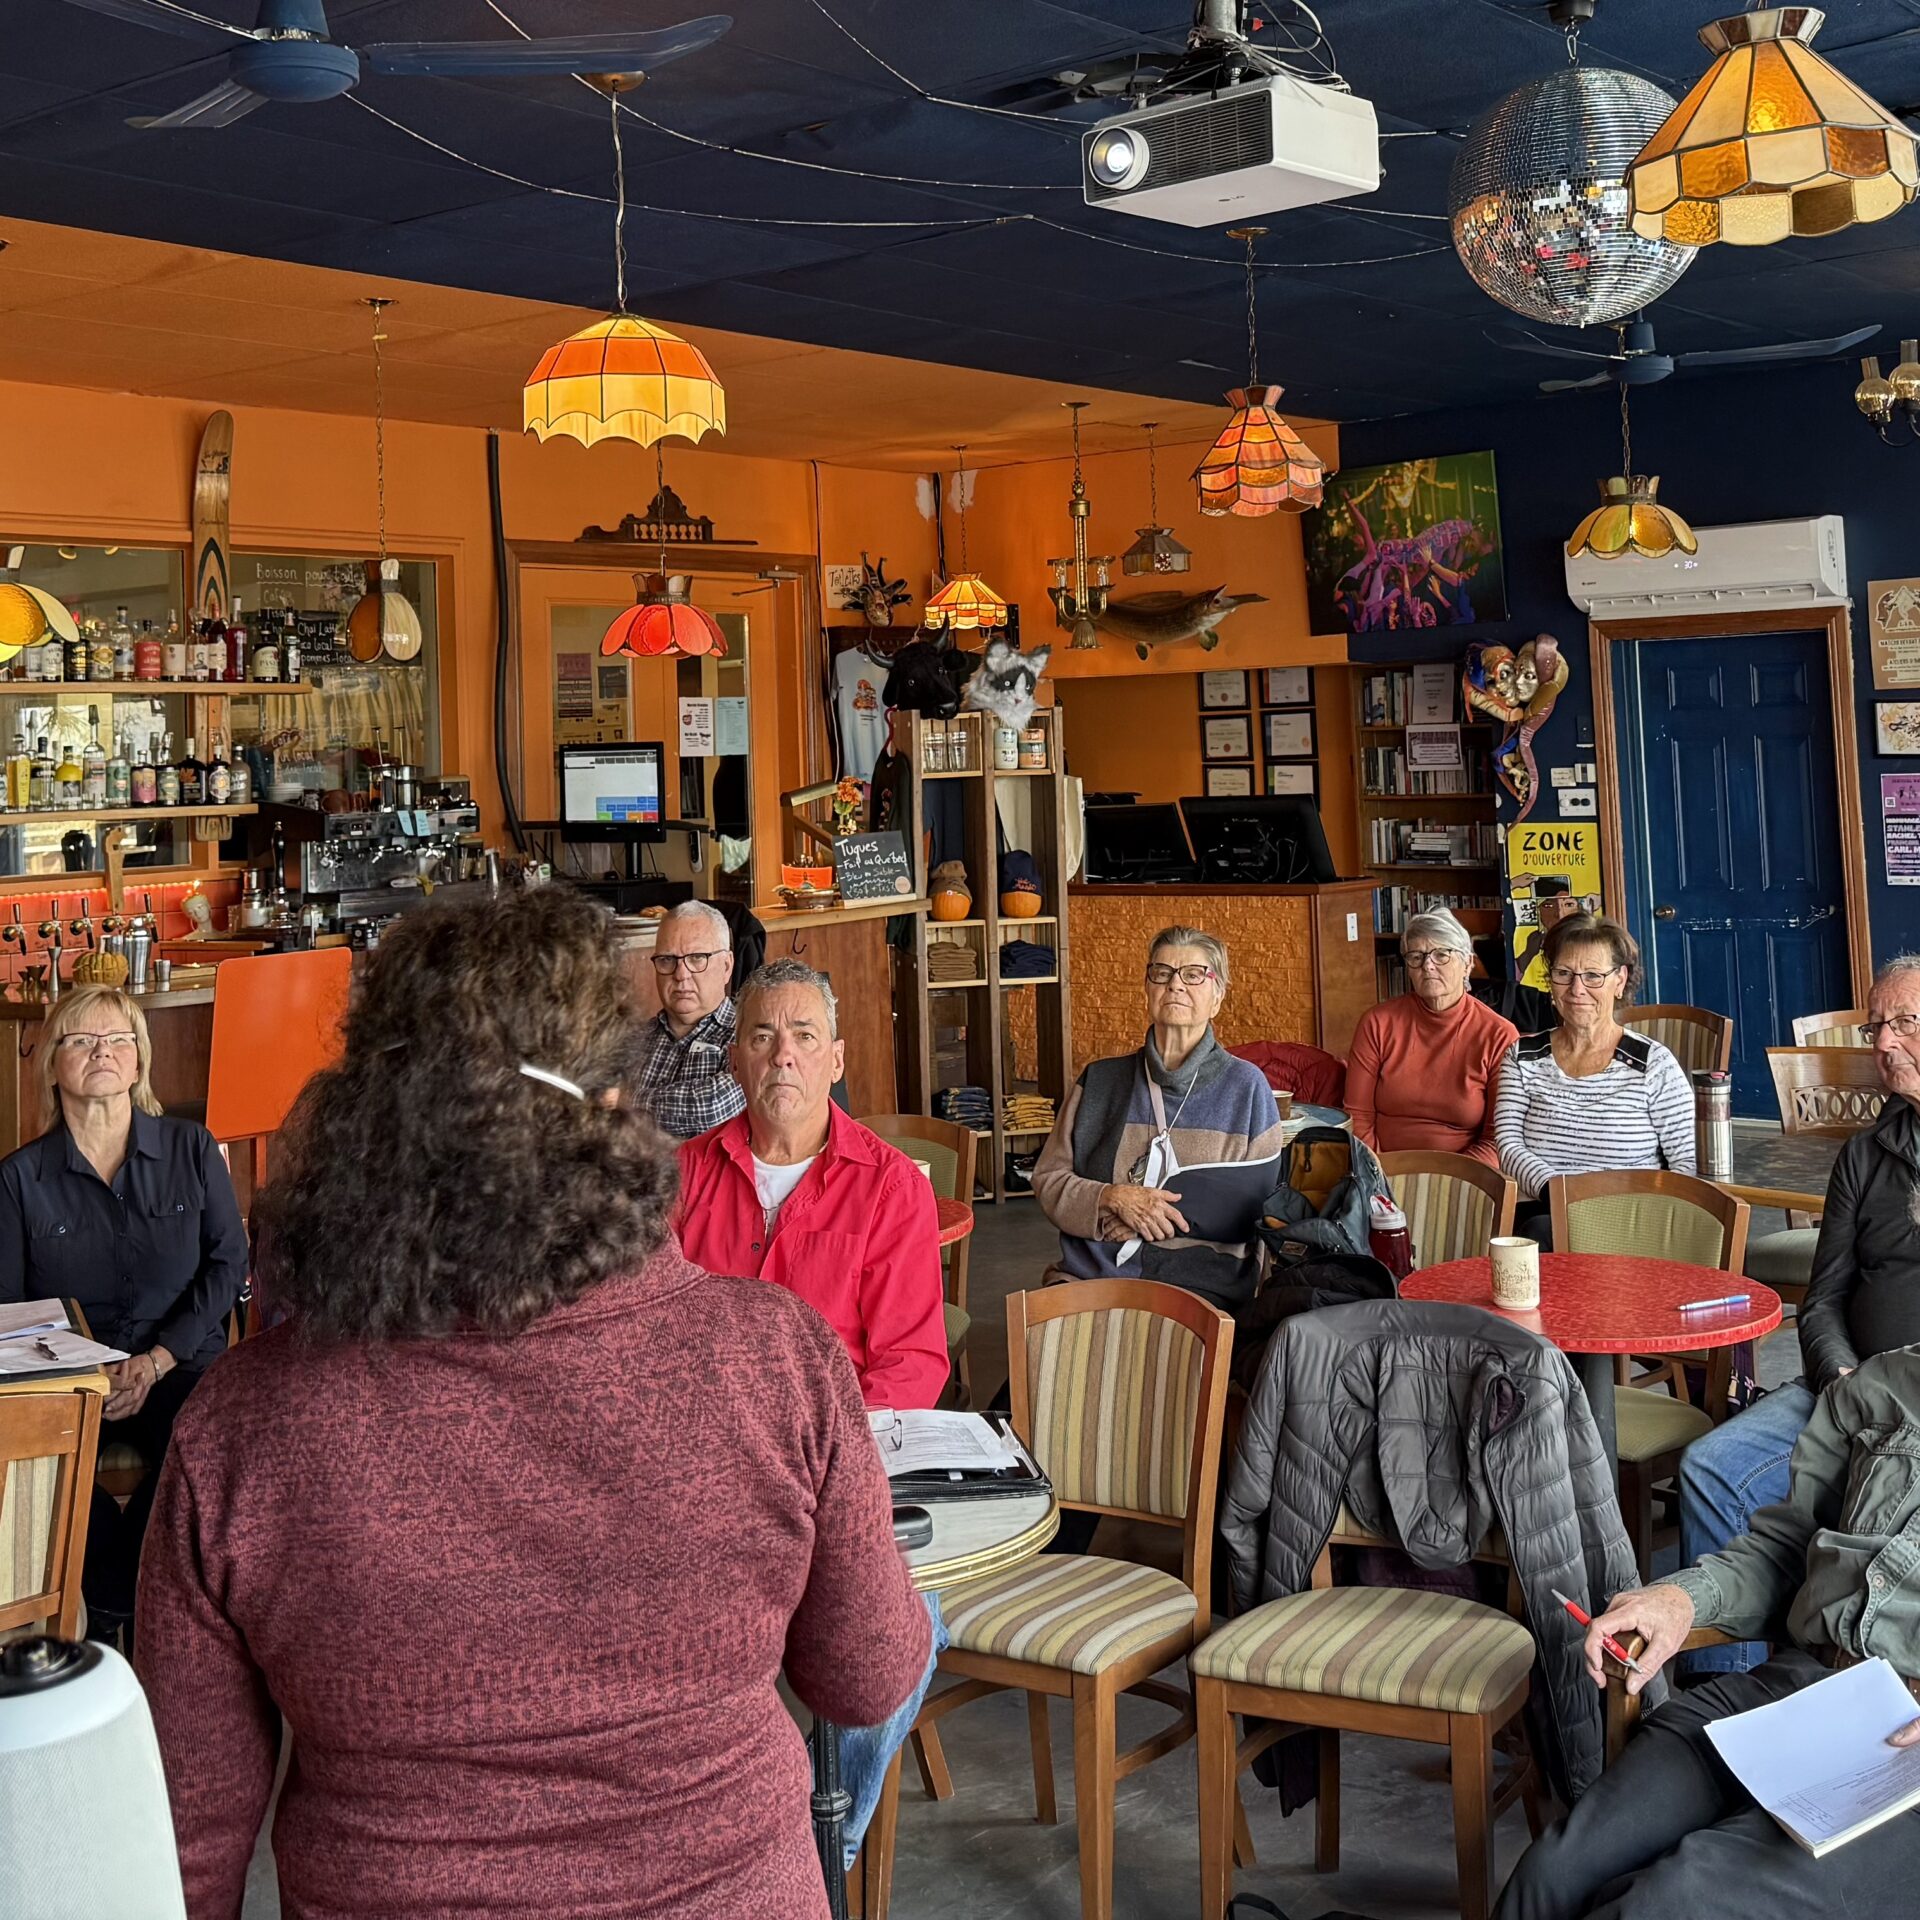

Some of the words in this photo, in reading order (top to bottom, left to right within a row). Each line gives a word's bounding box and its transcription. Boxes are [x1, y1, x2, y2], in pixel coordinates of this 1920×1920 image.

[256, 562, 297, 580] Boisson
[835, 839, 878, 857] Tuques
[1523, 831, 1584, 851] ZONE
[1523, 853, 1586, 866] D'OUVERTURE
